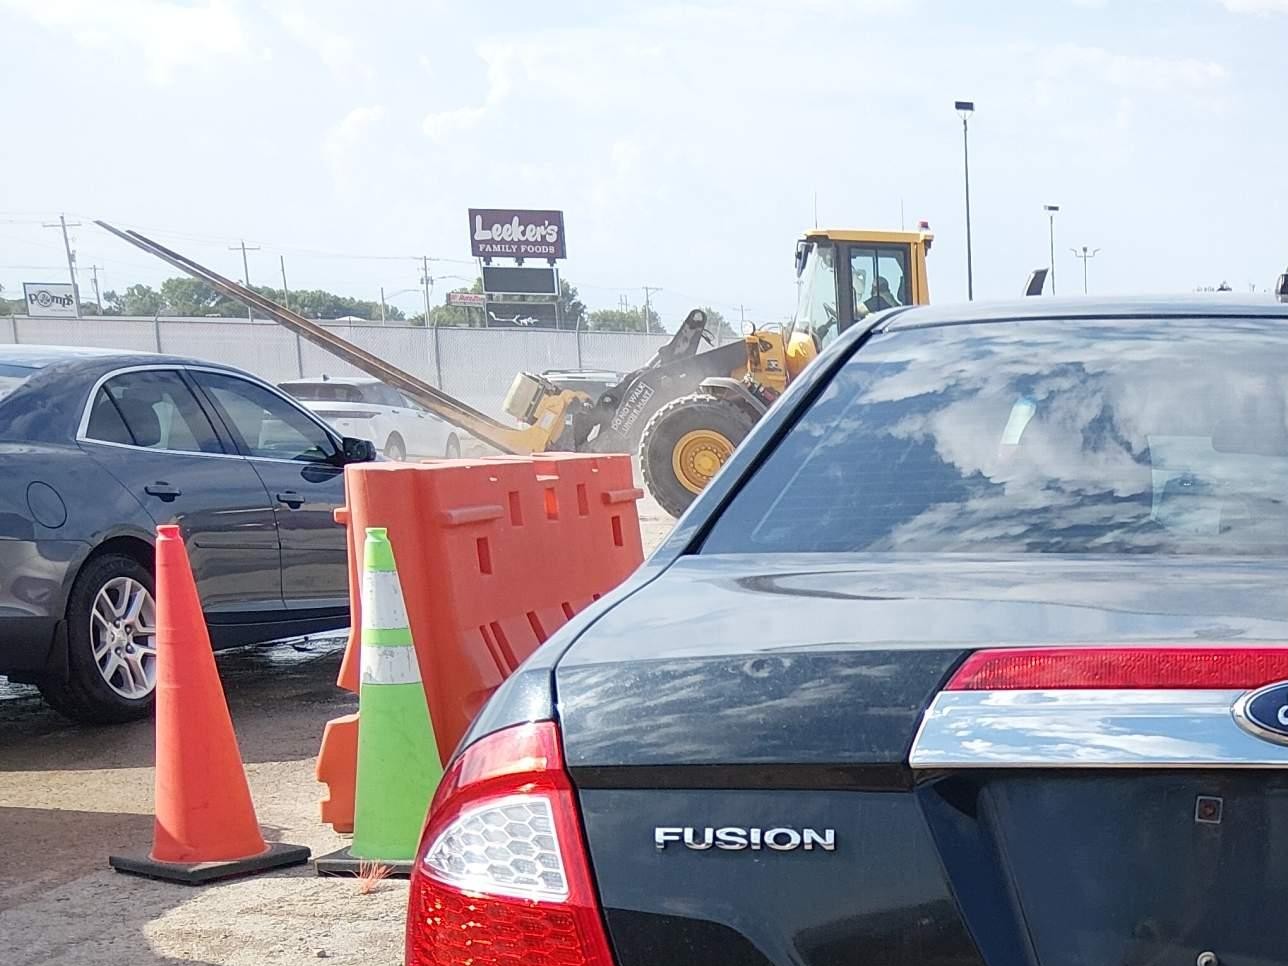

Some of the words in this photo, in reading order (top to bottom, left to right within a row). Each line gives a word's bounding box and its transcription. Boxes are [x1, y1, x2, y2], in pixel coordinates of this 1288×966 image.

[474, 215, 558, 243] Leeker's
[479, 243, 518, 253] FAMILY
[521, 245, 555, 254] FOODS
[611, 418, 622, 431] DO
[619, 402, 632, 419] NOT
[629, 383, 646, 403] WALK
[637, 390, 651, 409] MAST
[654, 827, 836, 851] FUSION
